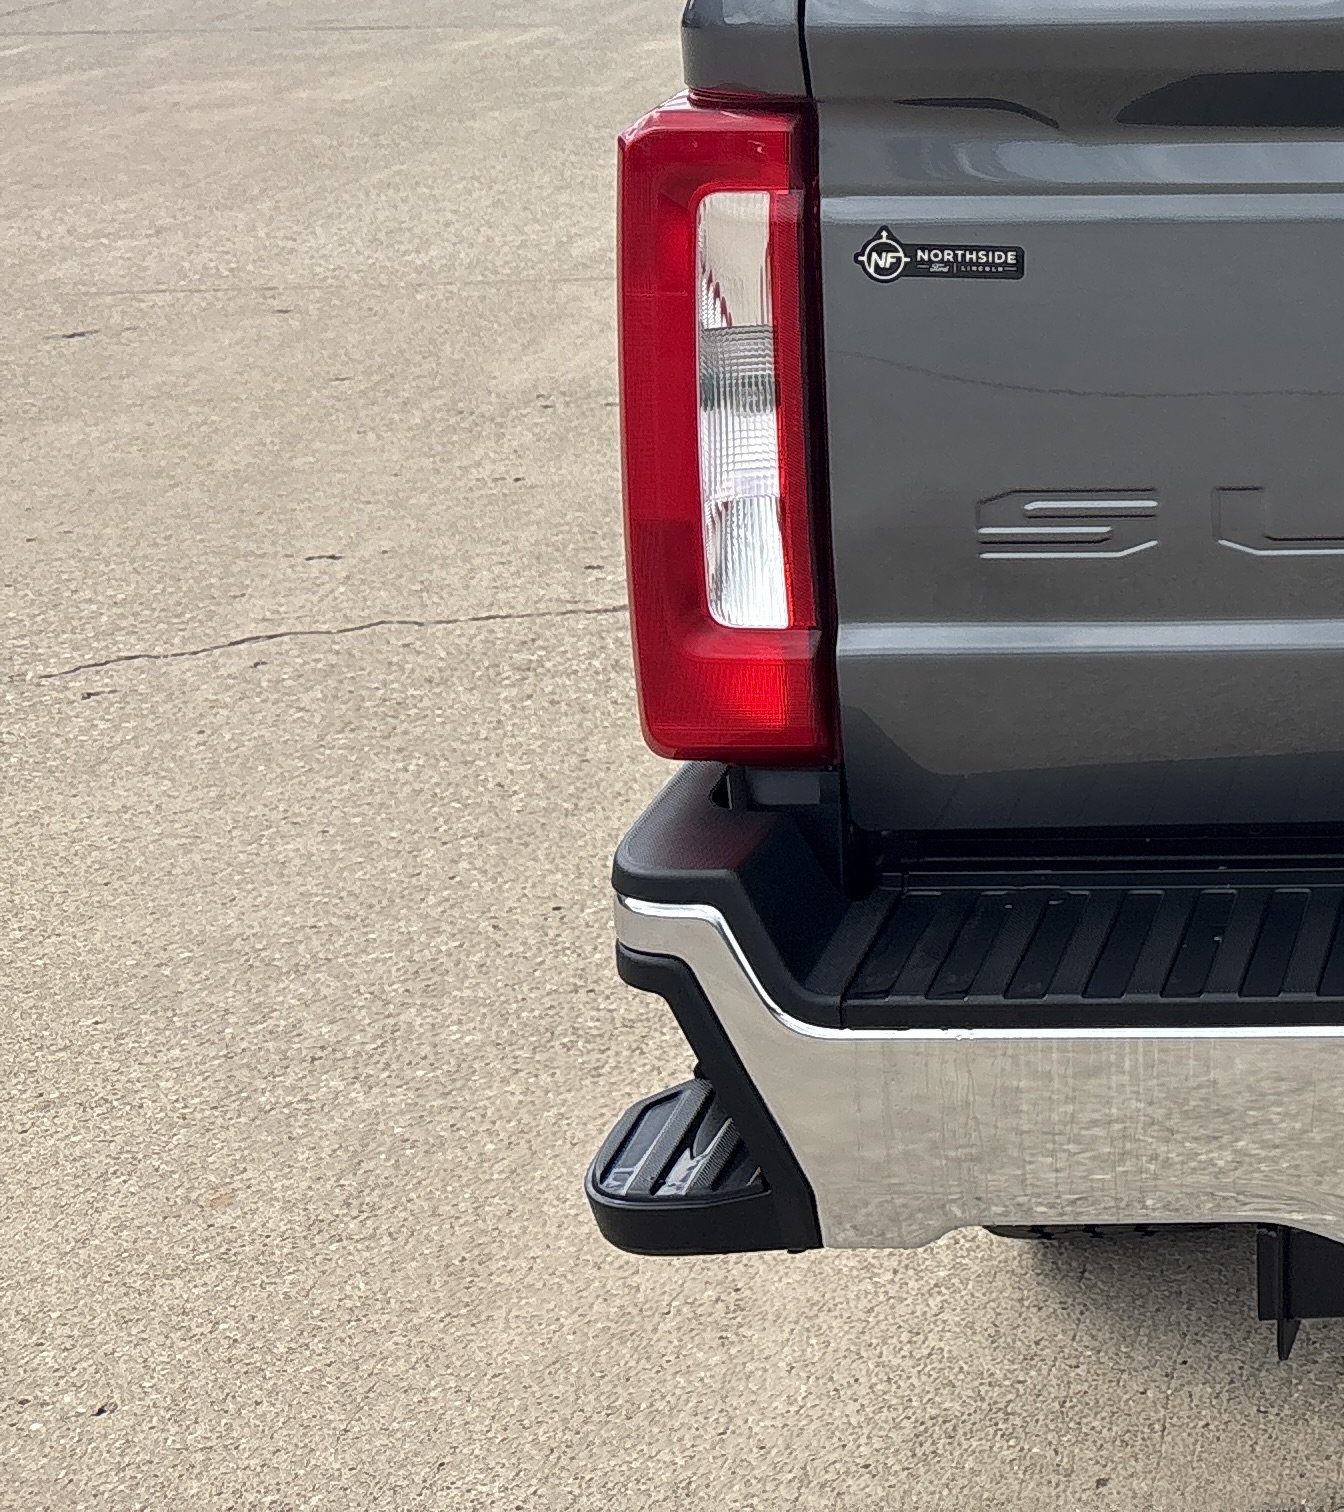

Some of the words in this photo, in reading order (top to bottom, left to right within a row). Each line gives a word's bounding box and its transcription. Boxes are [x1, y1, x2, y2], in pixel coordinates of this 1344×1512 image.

[870, 251, 902, 274] NF
[916, 248, 1018, 265] NORTHSIDE
[929, 262, 950, 273] Ford
[960, 265, 1004, 273] LINCOLN
